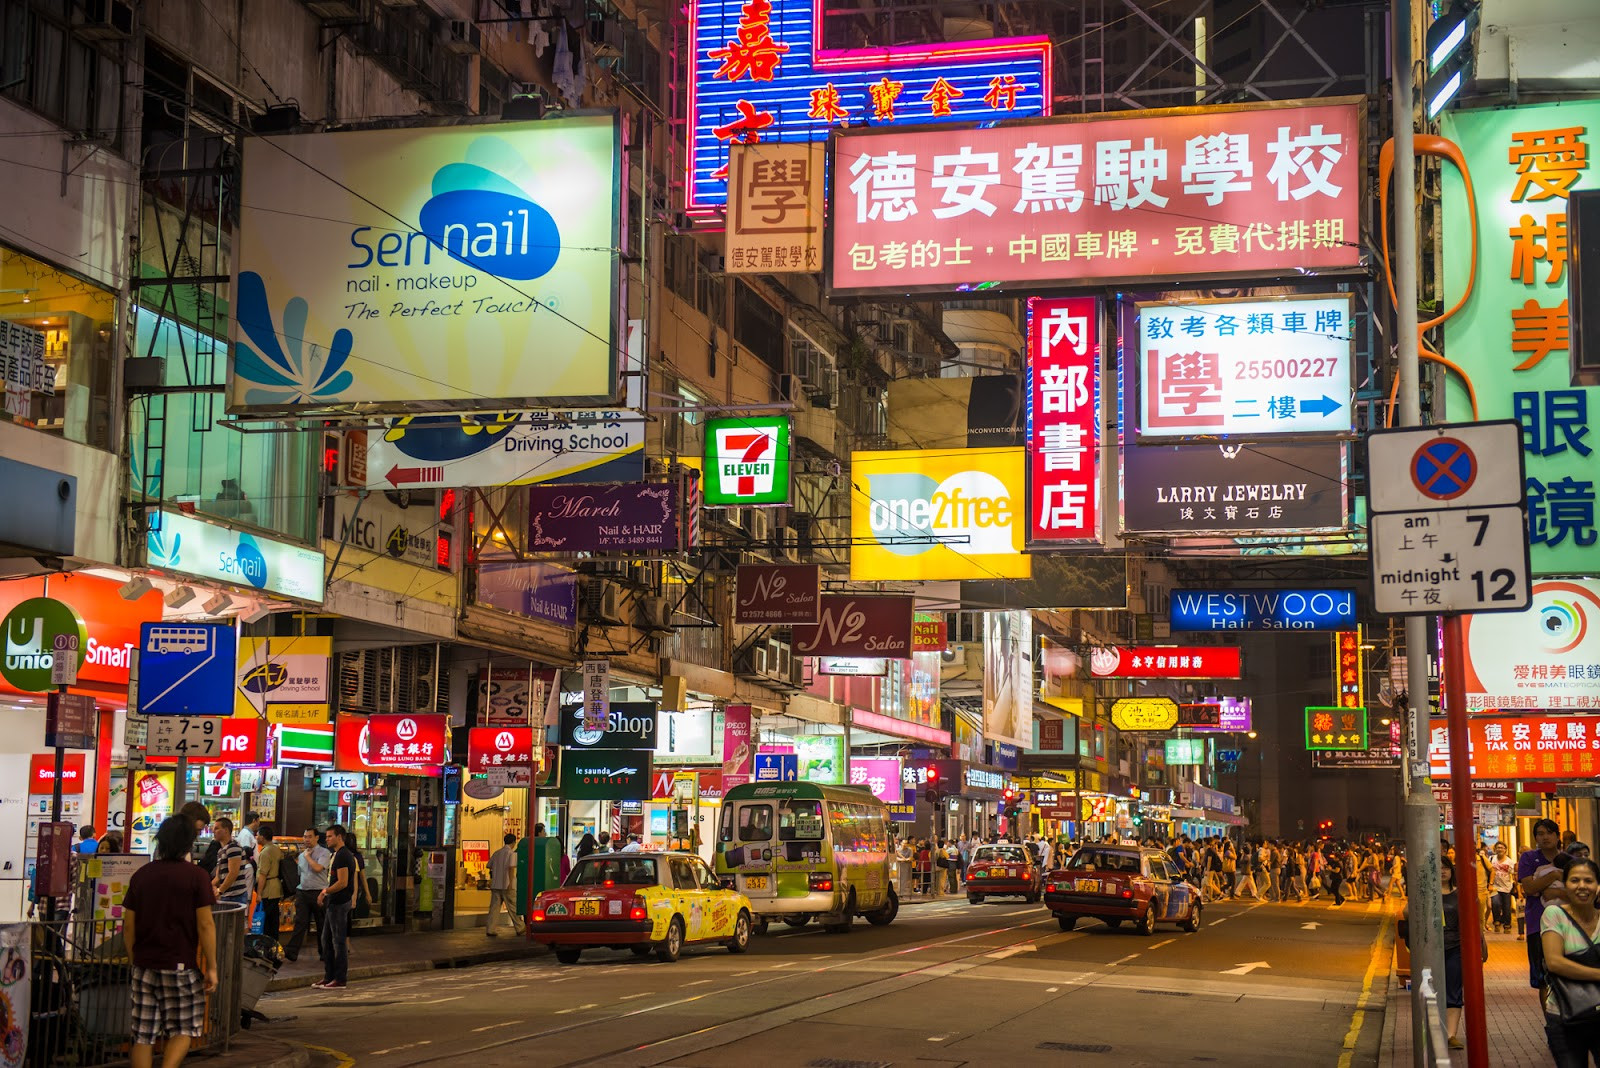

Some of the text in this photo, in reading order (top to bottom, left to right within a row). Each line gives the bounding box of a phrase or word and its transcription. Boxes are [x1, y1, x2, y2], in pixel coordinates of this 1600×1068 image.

[808, 75, 1026, 123] 珠寶金行
[848, 124, 1344, 224] 德安駕駛學校
[748, 158, 812, 224] 學
[731, 245, 817, 270] 德安駕駛學校
[848, 237, 974, 272] 包考的士
[1008, 228, 1139, 264] 中國車牌
[346, 273, 478, 293] nail makeup
[344, 296, 540, 320] The Perfect Touch
[1234, 358, 1339, 381] 25500227
[1161, 350, 1224, 416] 學
[1232, 395, 1297, 420] 二樓
[504, 431, 629, 454] Driving School
[1157, 484, 1308, 503] LARRY JEWELRY
[547, 495, 622, 520] March
[869, 487, 1013, 532] one2free
[1404, 515, 1430, 528] am
[1466, 514, 1490, 547] 7
[599, 525, 663, 537] Nail & HAIR
[1398, 533, 1439, 551] 上午
[1381, 567, 1460, 585] midnight
[1471, 568, 1516, 602] 12
[786, 593, 814, 604] Salon
[1401, 588, 1442, 605] 午夜
[530, 597, 543, 614] Nail
[550, 602, 568, 620] HAIR
[914, 625, 939, 635] Nail
[1211, 617, 1315, 629] Hair Salon
[864, 635, 905, 651] Salon
[914, 635, 939, 645] Box
[6, 655, 54, 670] Unio
[156, 726, 174, 735] 上午
[606, 712, 654, 739] Shop
[156, 745, 172, 754] 下午
[380, 743, 434, 756] 永隆銀行
[1485, 741, 1509, 751] TAK
[1514, 741, 1531, 751] ON
[1537, 740, 1587, 750] DRIVING
[480, 753, 529, 765] 永隆銀行
[39, 769, 77, 778] Smaone
[575, 766, 611, 775] le saunda
[584, 777, 631, 785] OUTLET
[850, 767, 886, 796] 莎莎
